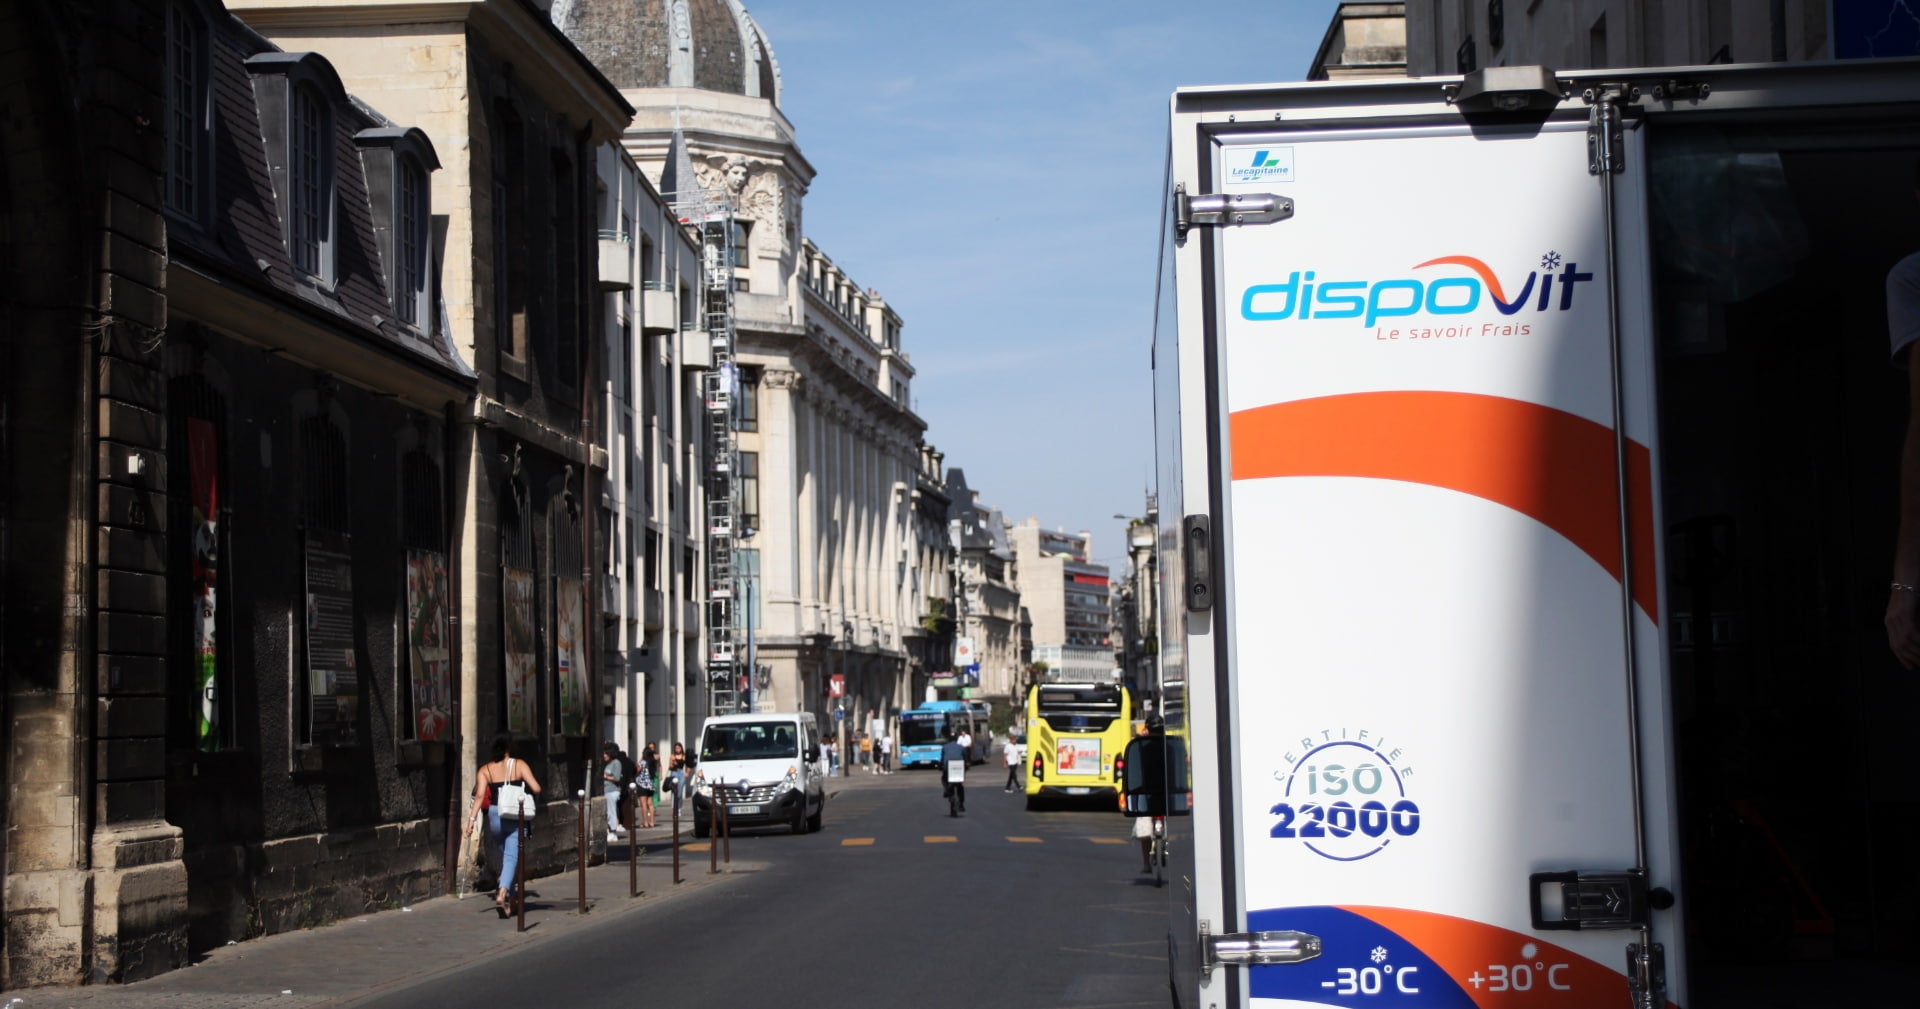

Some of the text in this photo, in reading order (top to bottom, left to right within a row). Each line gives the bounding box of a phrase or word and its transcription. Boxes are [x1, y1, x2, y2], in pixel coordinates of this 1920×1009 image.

[1232, 166, 1289, 177] Lecapitaine
[1376, 322, 1531, 340] Le savoir Frais
[1269, 800, 1421, 838] 22000
[1321, 964, 1419, 995] -30°C
[1467, 961, 1571, 992] +30°C
